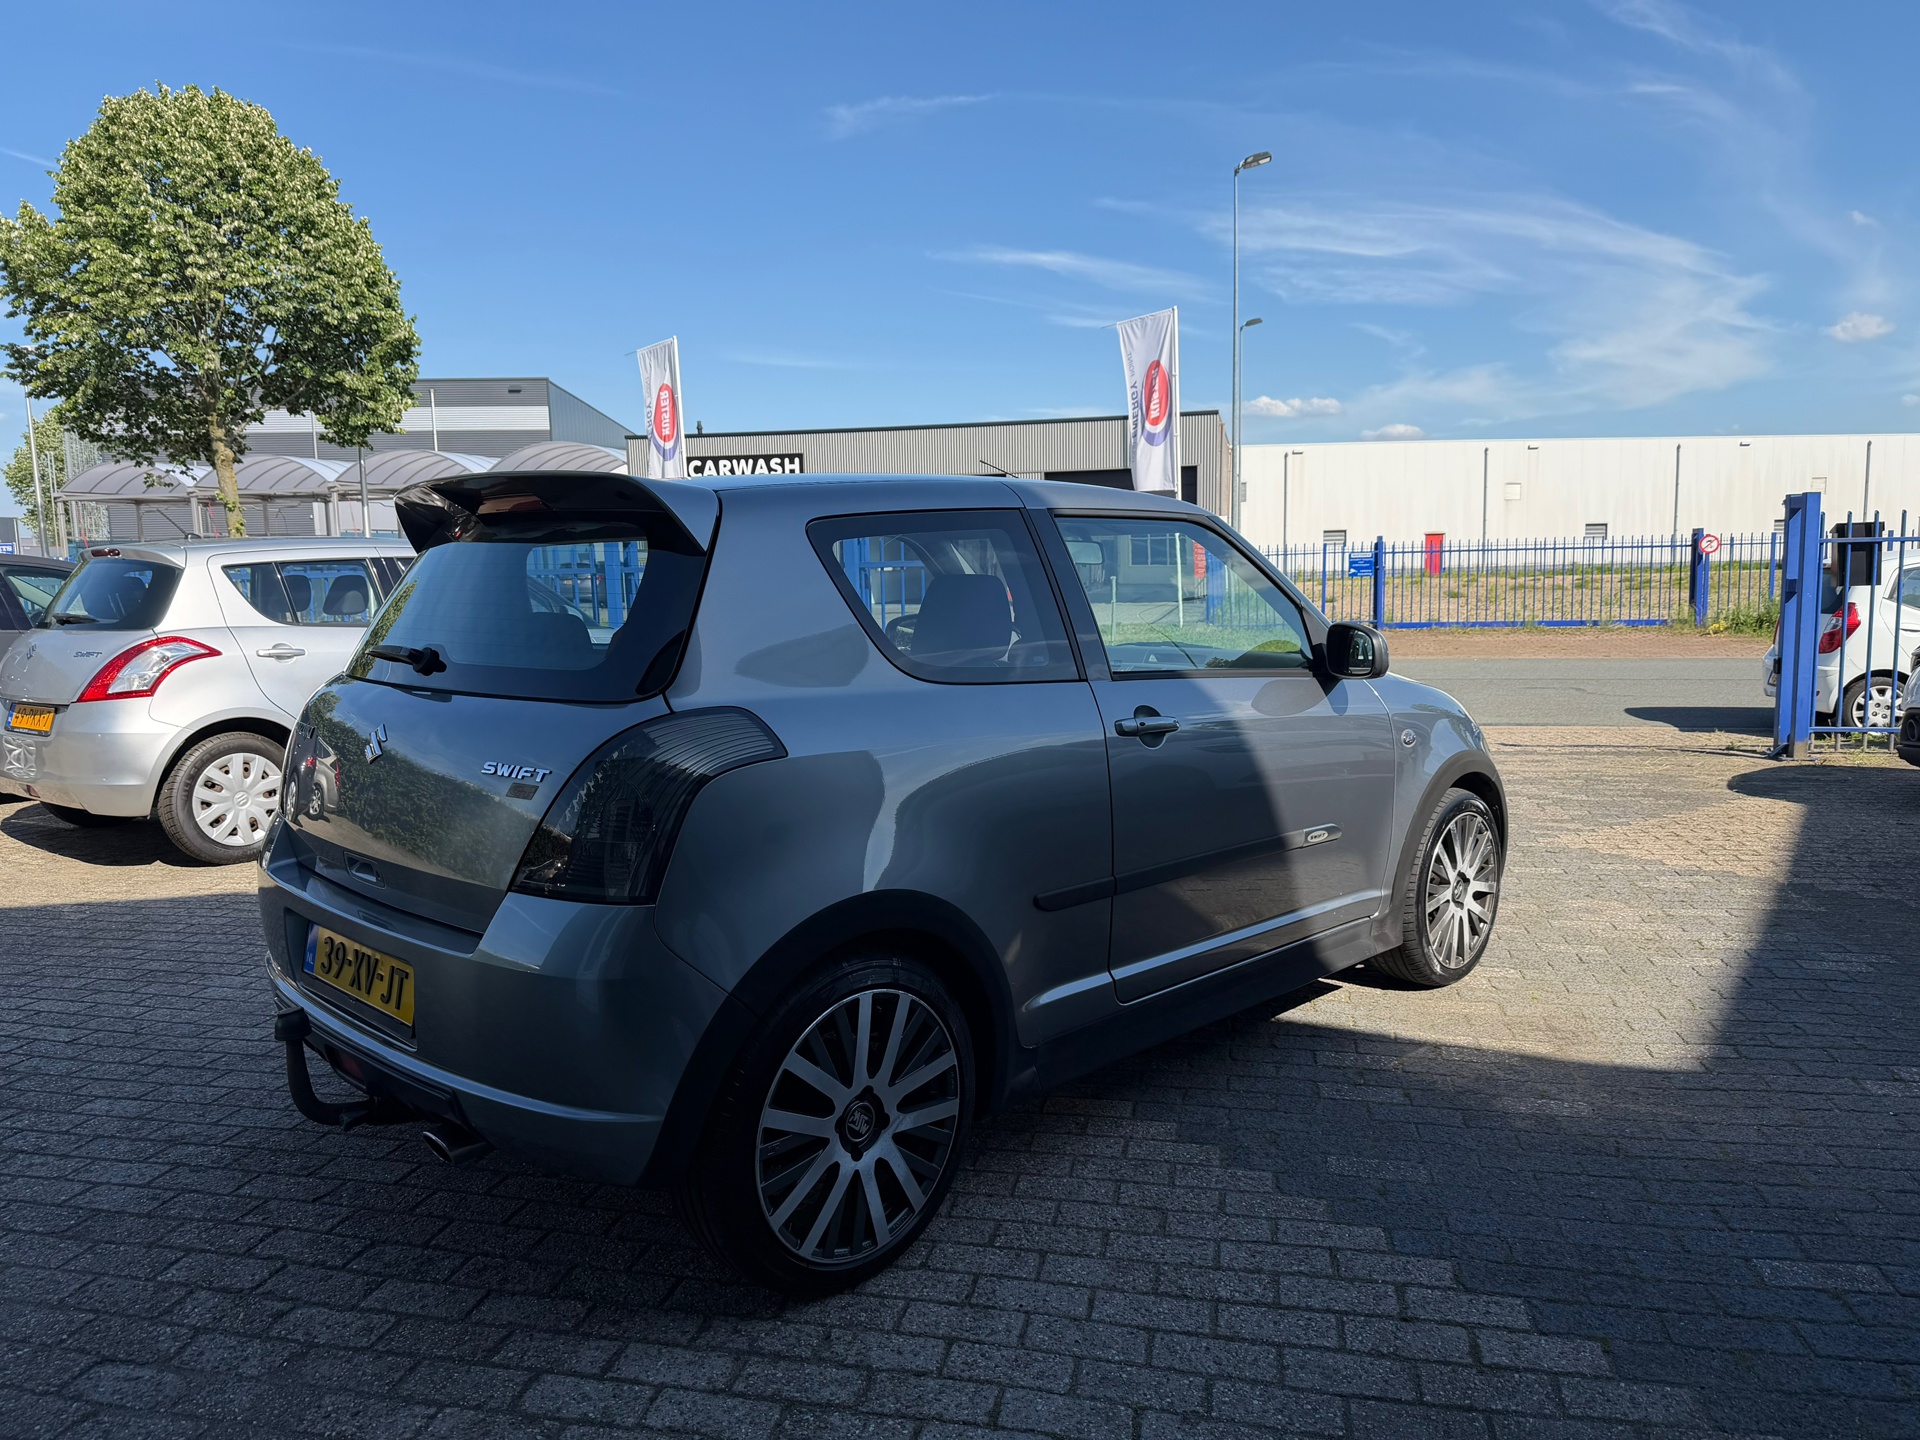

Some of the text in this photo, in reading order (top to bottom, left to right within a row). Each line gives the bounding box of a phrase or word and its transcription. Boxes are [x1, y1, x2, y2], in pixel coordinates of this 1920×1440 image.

[688, 457, 800, 477] CARWASH
[481, 761, 552, 782] SWIFT
[320, 936, 410, 1011] 39-XV-JT
